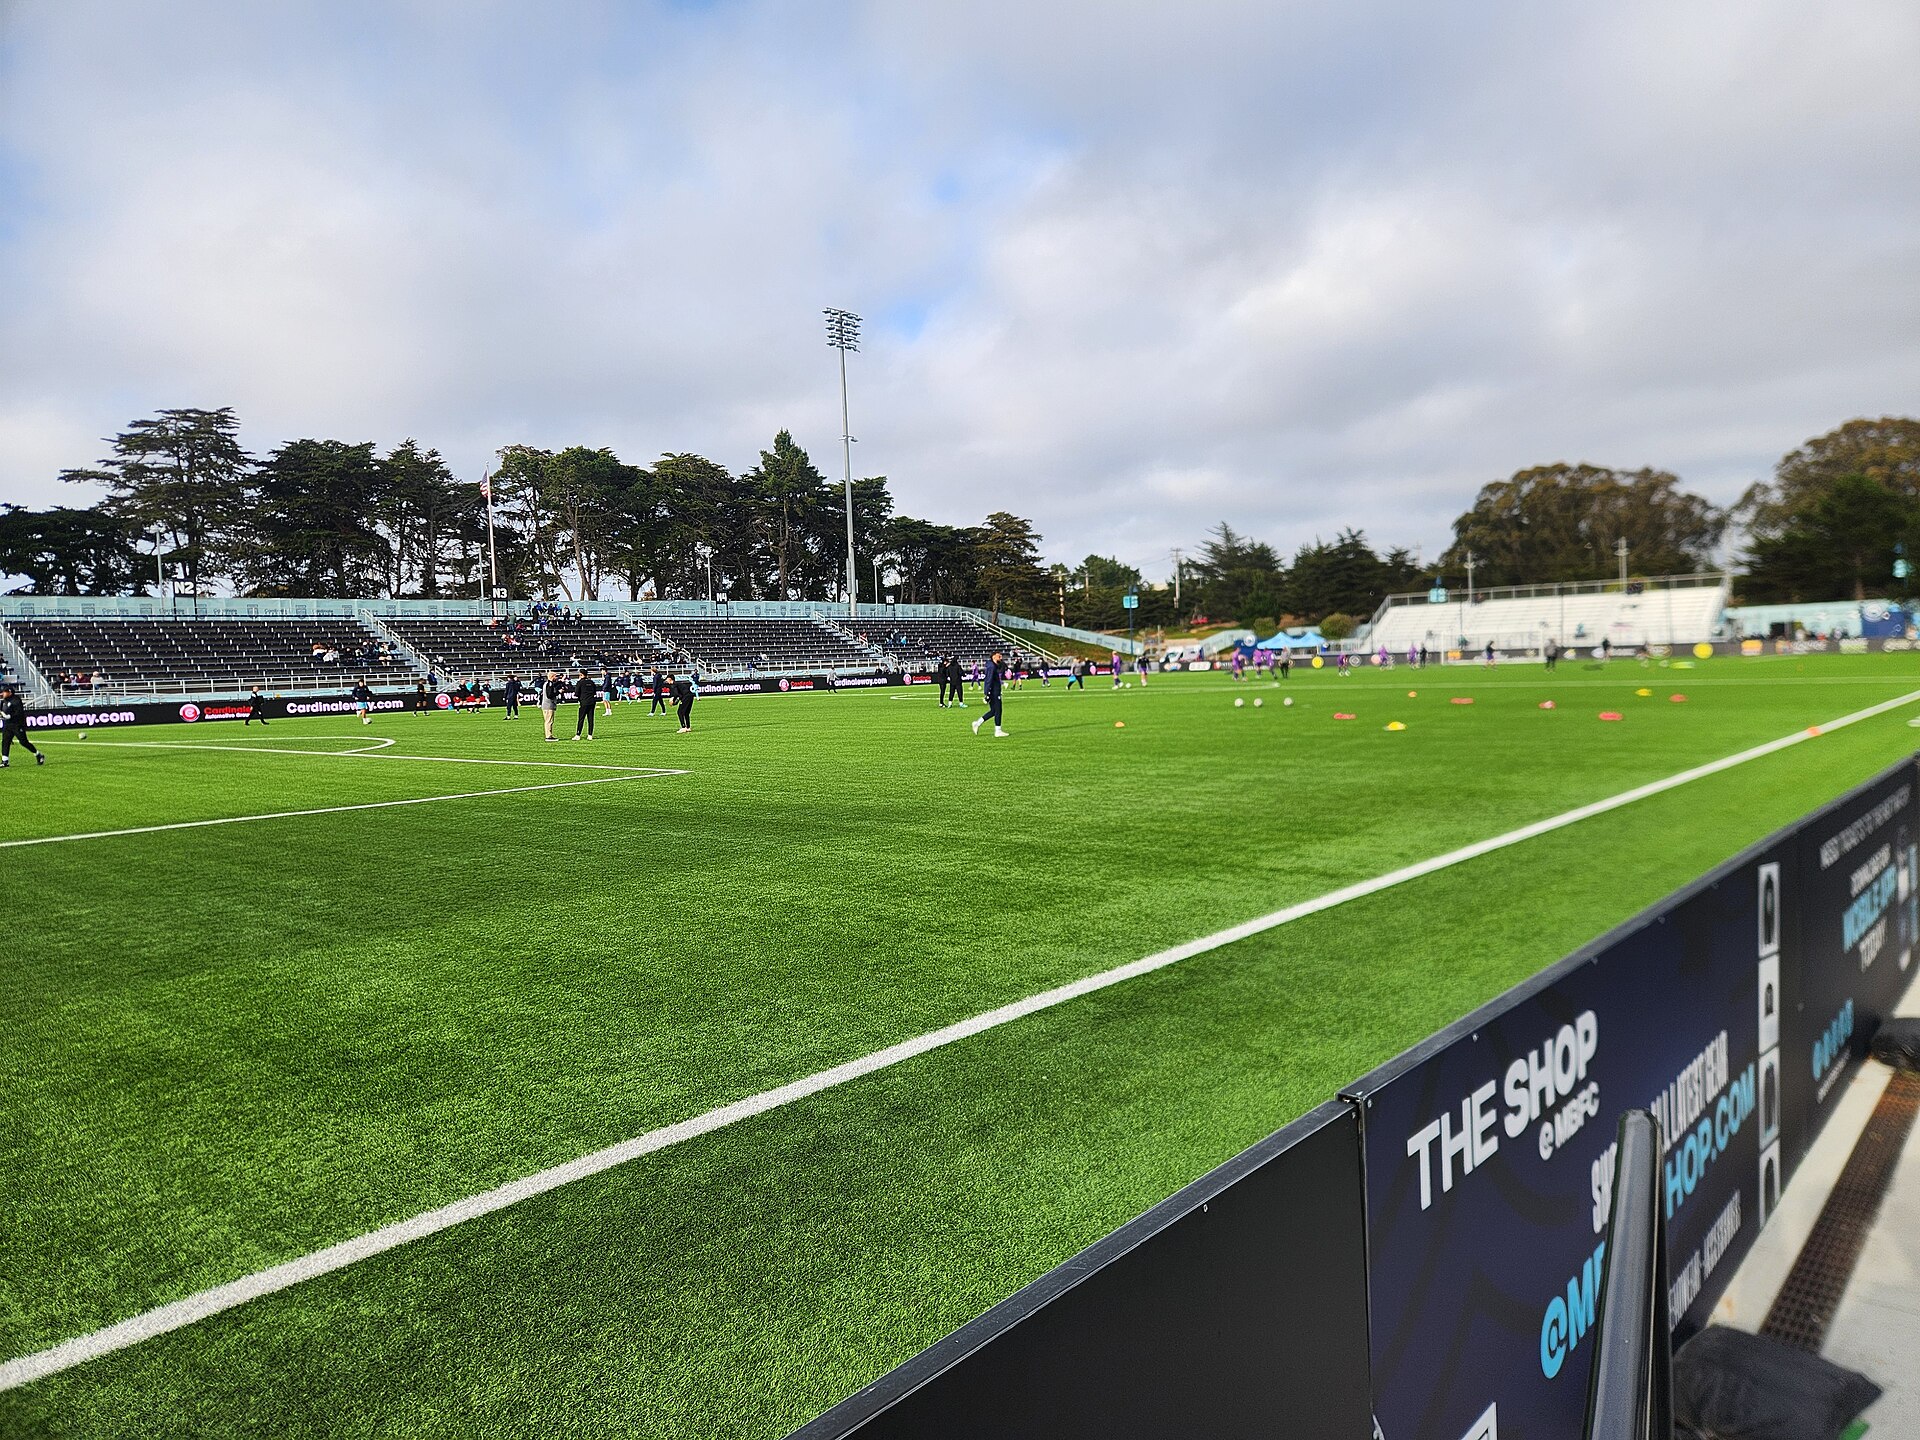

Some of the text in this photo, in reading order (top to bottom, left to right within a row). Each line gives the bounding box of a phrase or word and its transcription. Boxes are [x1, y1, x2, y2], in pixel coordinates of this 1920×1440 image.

[174, 581, 195, 595] N2
[492, 587, 508, 599] N3
[716, 592, 728, 602] N4
[833, 677, 888, 687] ardinaleway.com
[285, 700, 405, 714] Cardinalewy.com
[0, 711, 135, 729] naleway.com
[1407, 1079, 1499, 1210] THE
[1504, 1010, 1598, 1138] SHOP
